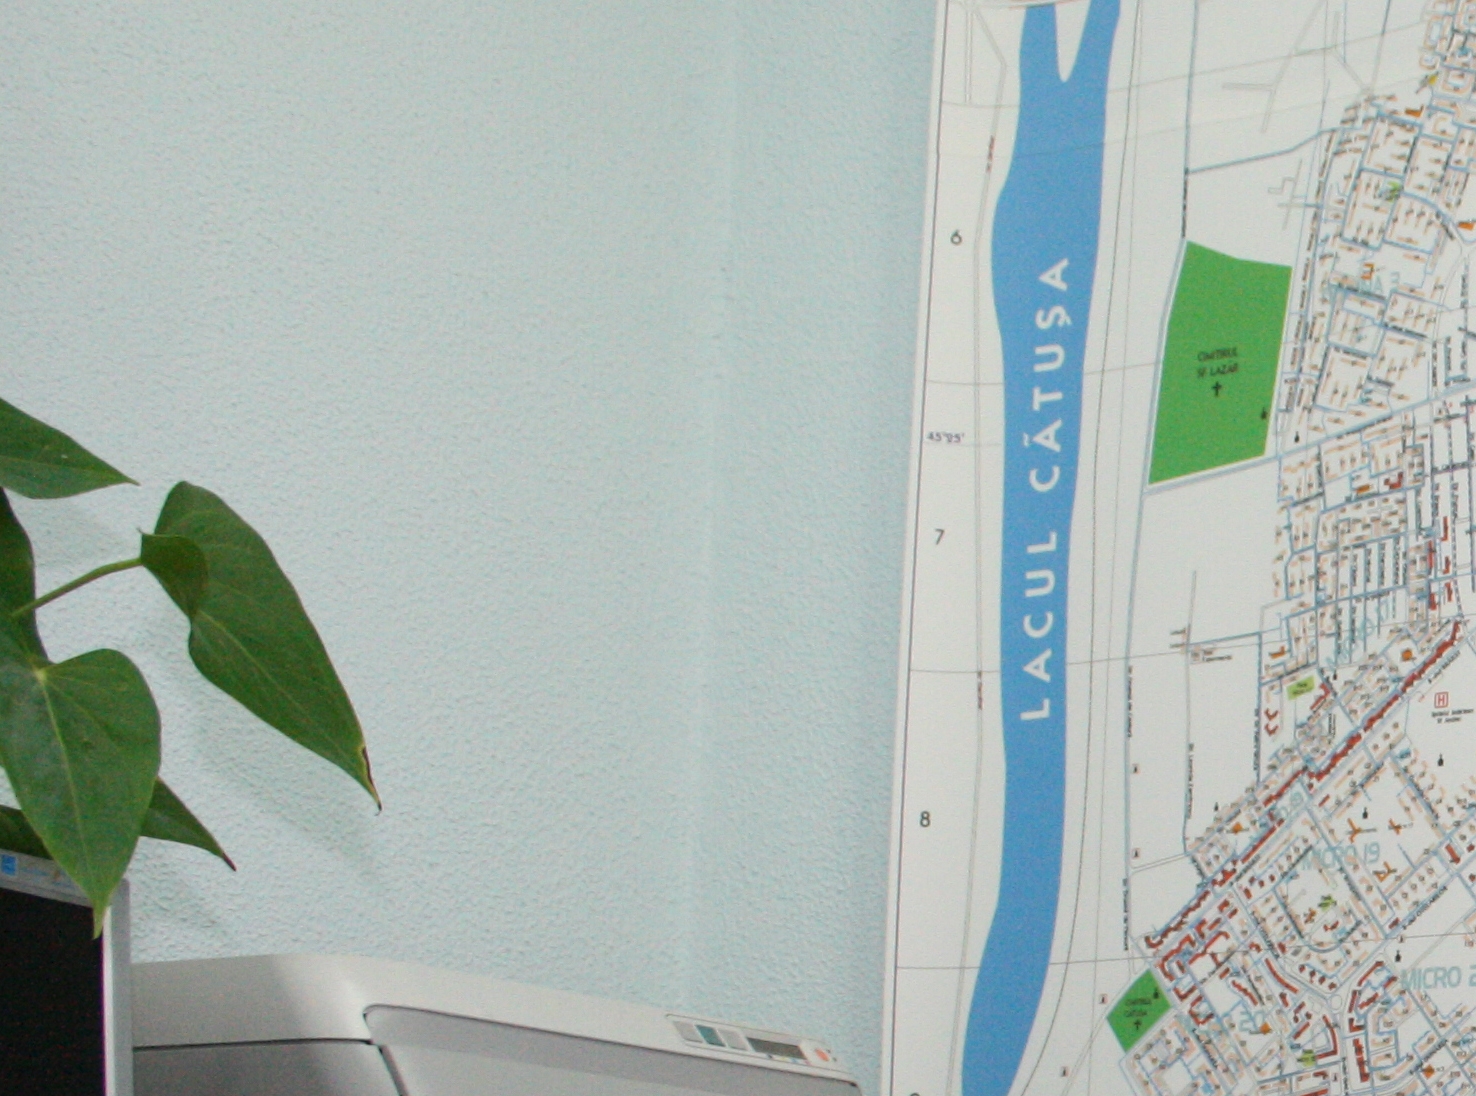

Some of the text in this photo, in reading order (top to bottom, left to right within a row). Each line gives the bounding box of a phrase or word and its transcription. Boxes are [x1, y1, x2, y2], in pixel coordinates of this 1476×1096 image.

[951, 229, 962, 246] 6
[935, 528, 945, 545] 7
[1020, 530, 1058, 721] LACUL
[919, 811, 931, 828] 8
[1401, 966, 1462, 990] MICRO
